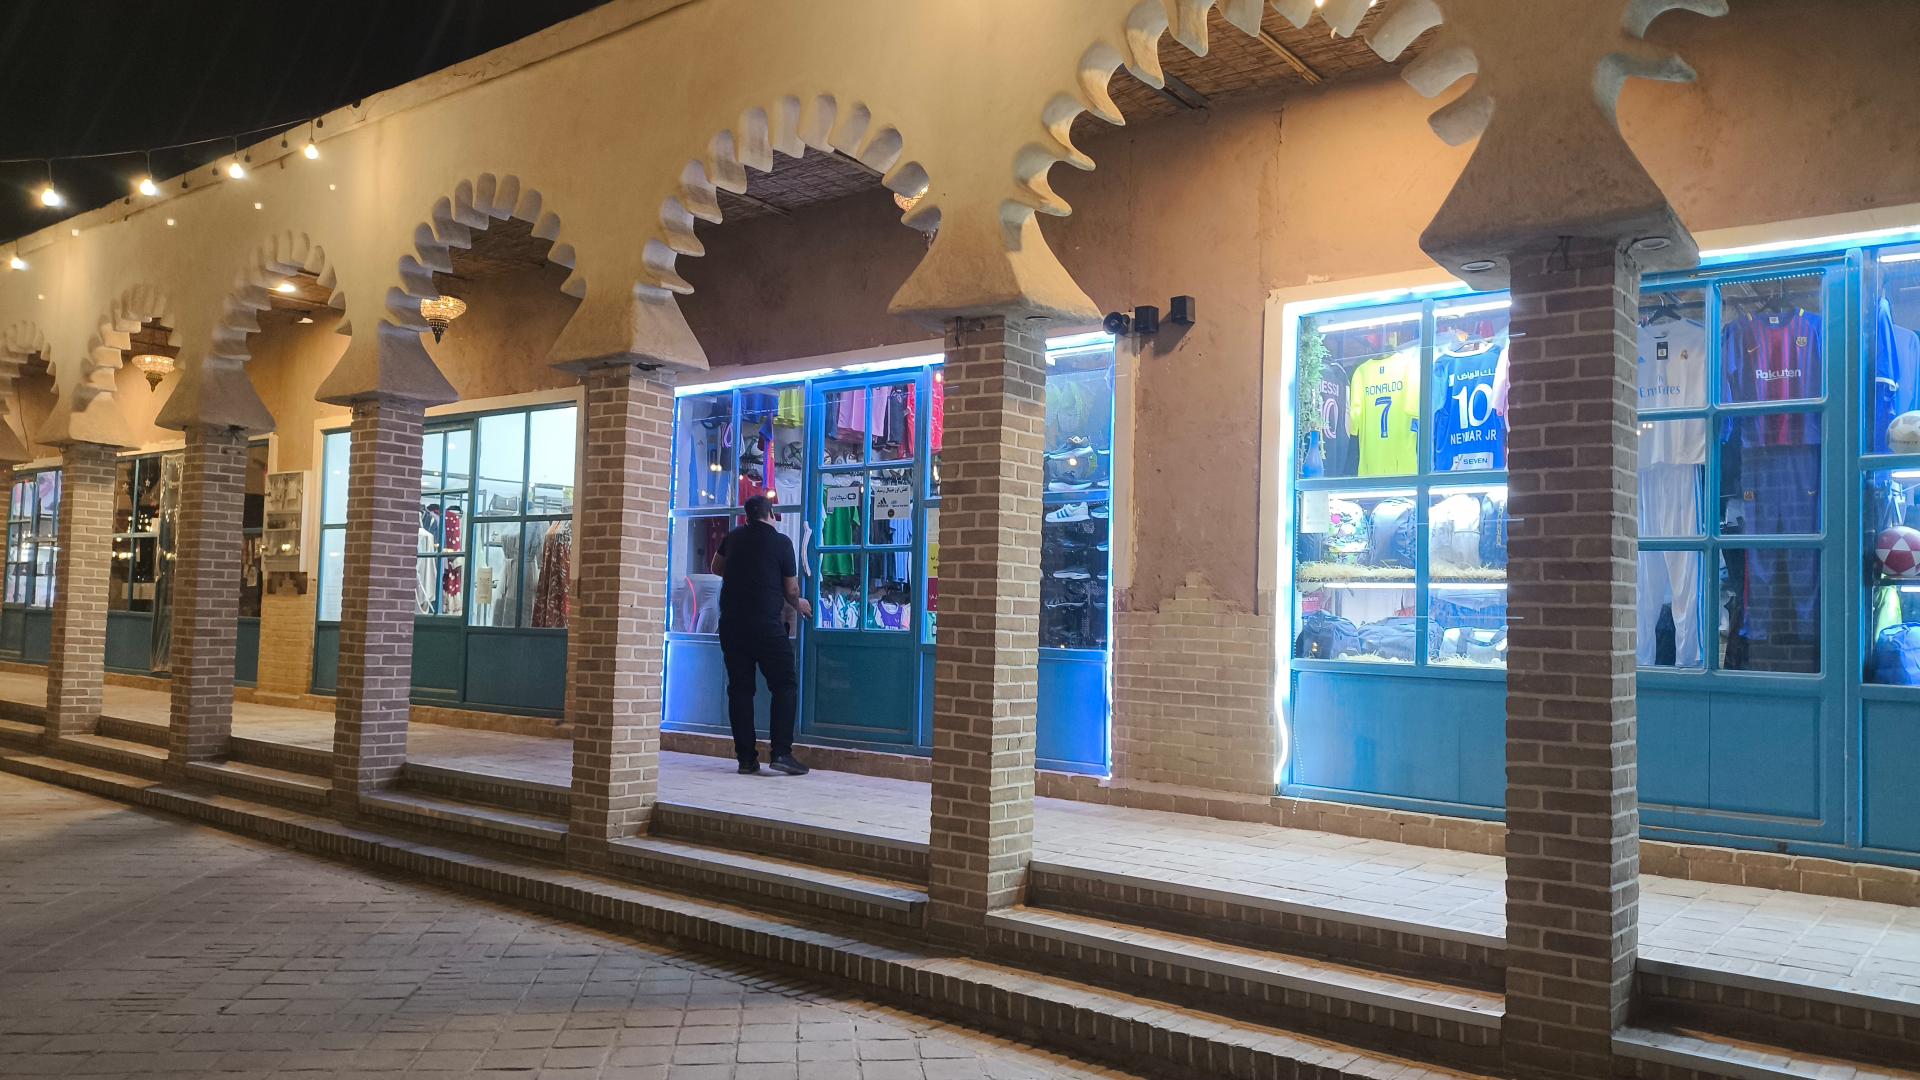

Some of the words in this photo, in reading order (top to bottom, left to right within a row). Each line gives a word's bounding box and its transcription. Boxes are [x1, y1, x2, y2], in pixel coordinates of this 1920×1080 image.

[1755, 368, 1801, 380] Rakuten
[1365, 380, 1403, 397] RONALDO
[1452, 383, 1493, 429] 10
[1375, 396, 1392, 438] 7
[1485, 429, 1497, 441] JR
[1463, 457, 1488, 465] SEVEN
